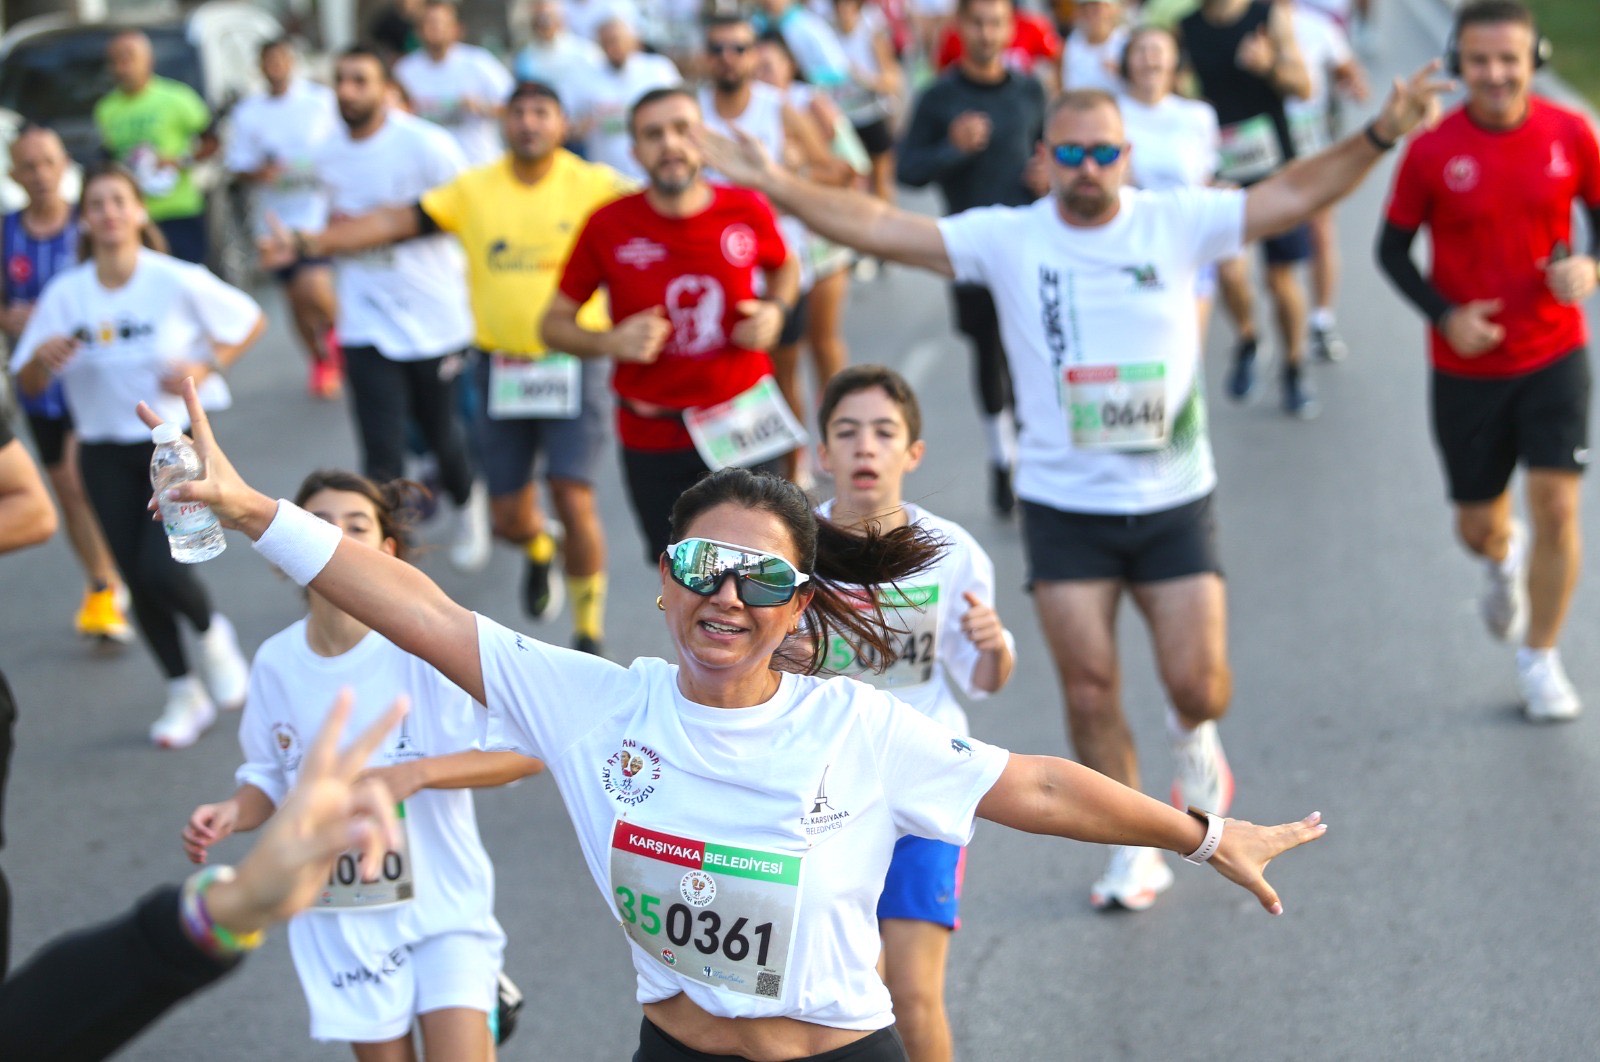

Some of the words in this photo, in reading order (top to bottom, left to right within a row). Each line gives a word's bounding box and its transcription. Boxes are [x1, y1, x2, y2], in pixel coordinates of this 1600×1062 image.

[817, 632, 934, 673] 5042
[602, 766, 616, 793] SAYGI
[616, 785, 655, 807] KOŞUSU
[805, 820, 843, 835] BELEDİYESİ
[810, 810, 850, 825] KARŞIYAKA
[628, 833, 701, 862] KARŞIYAKA
[704, 851, 783, 875] BELEDİYESİ
[615, 885, 773, 967] 350361
